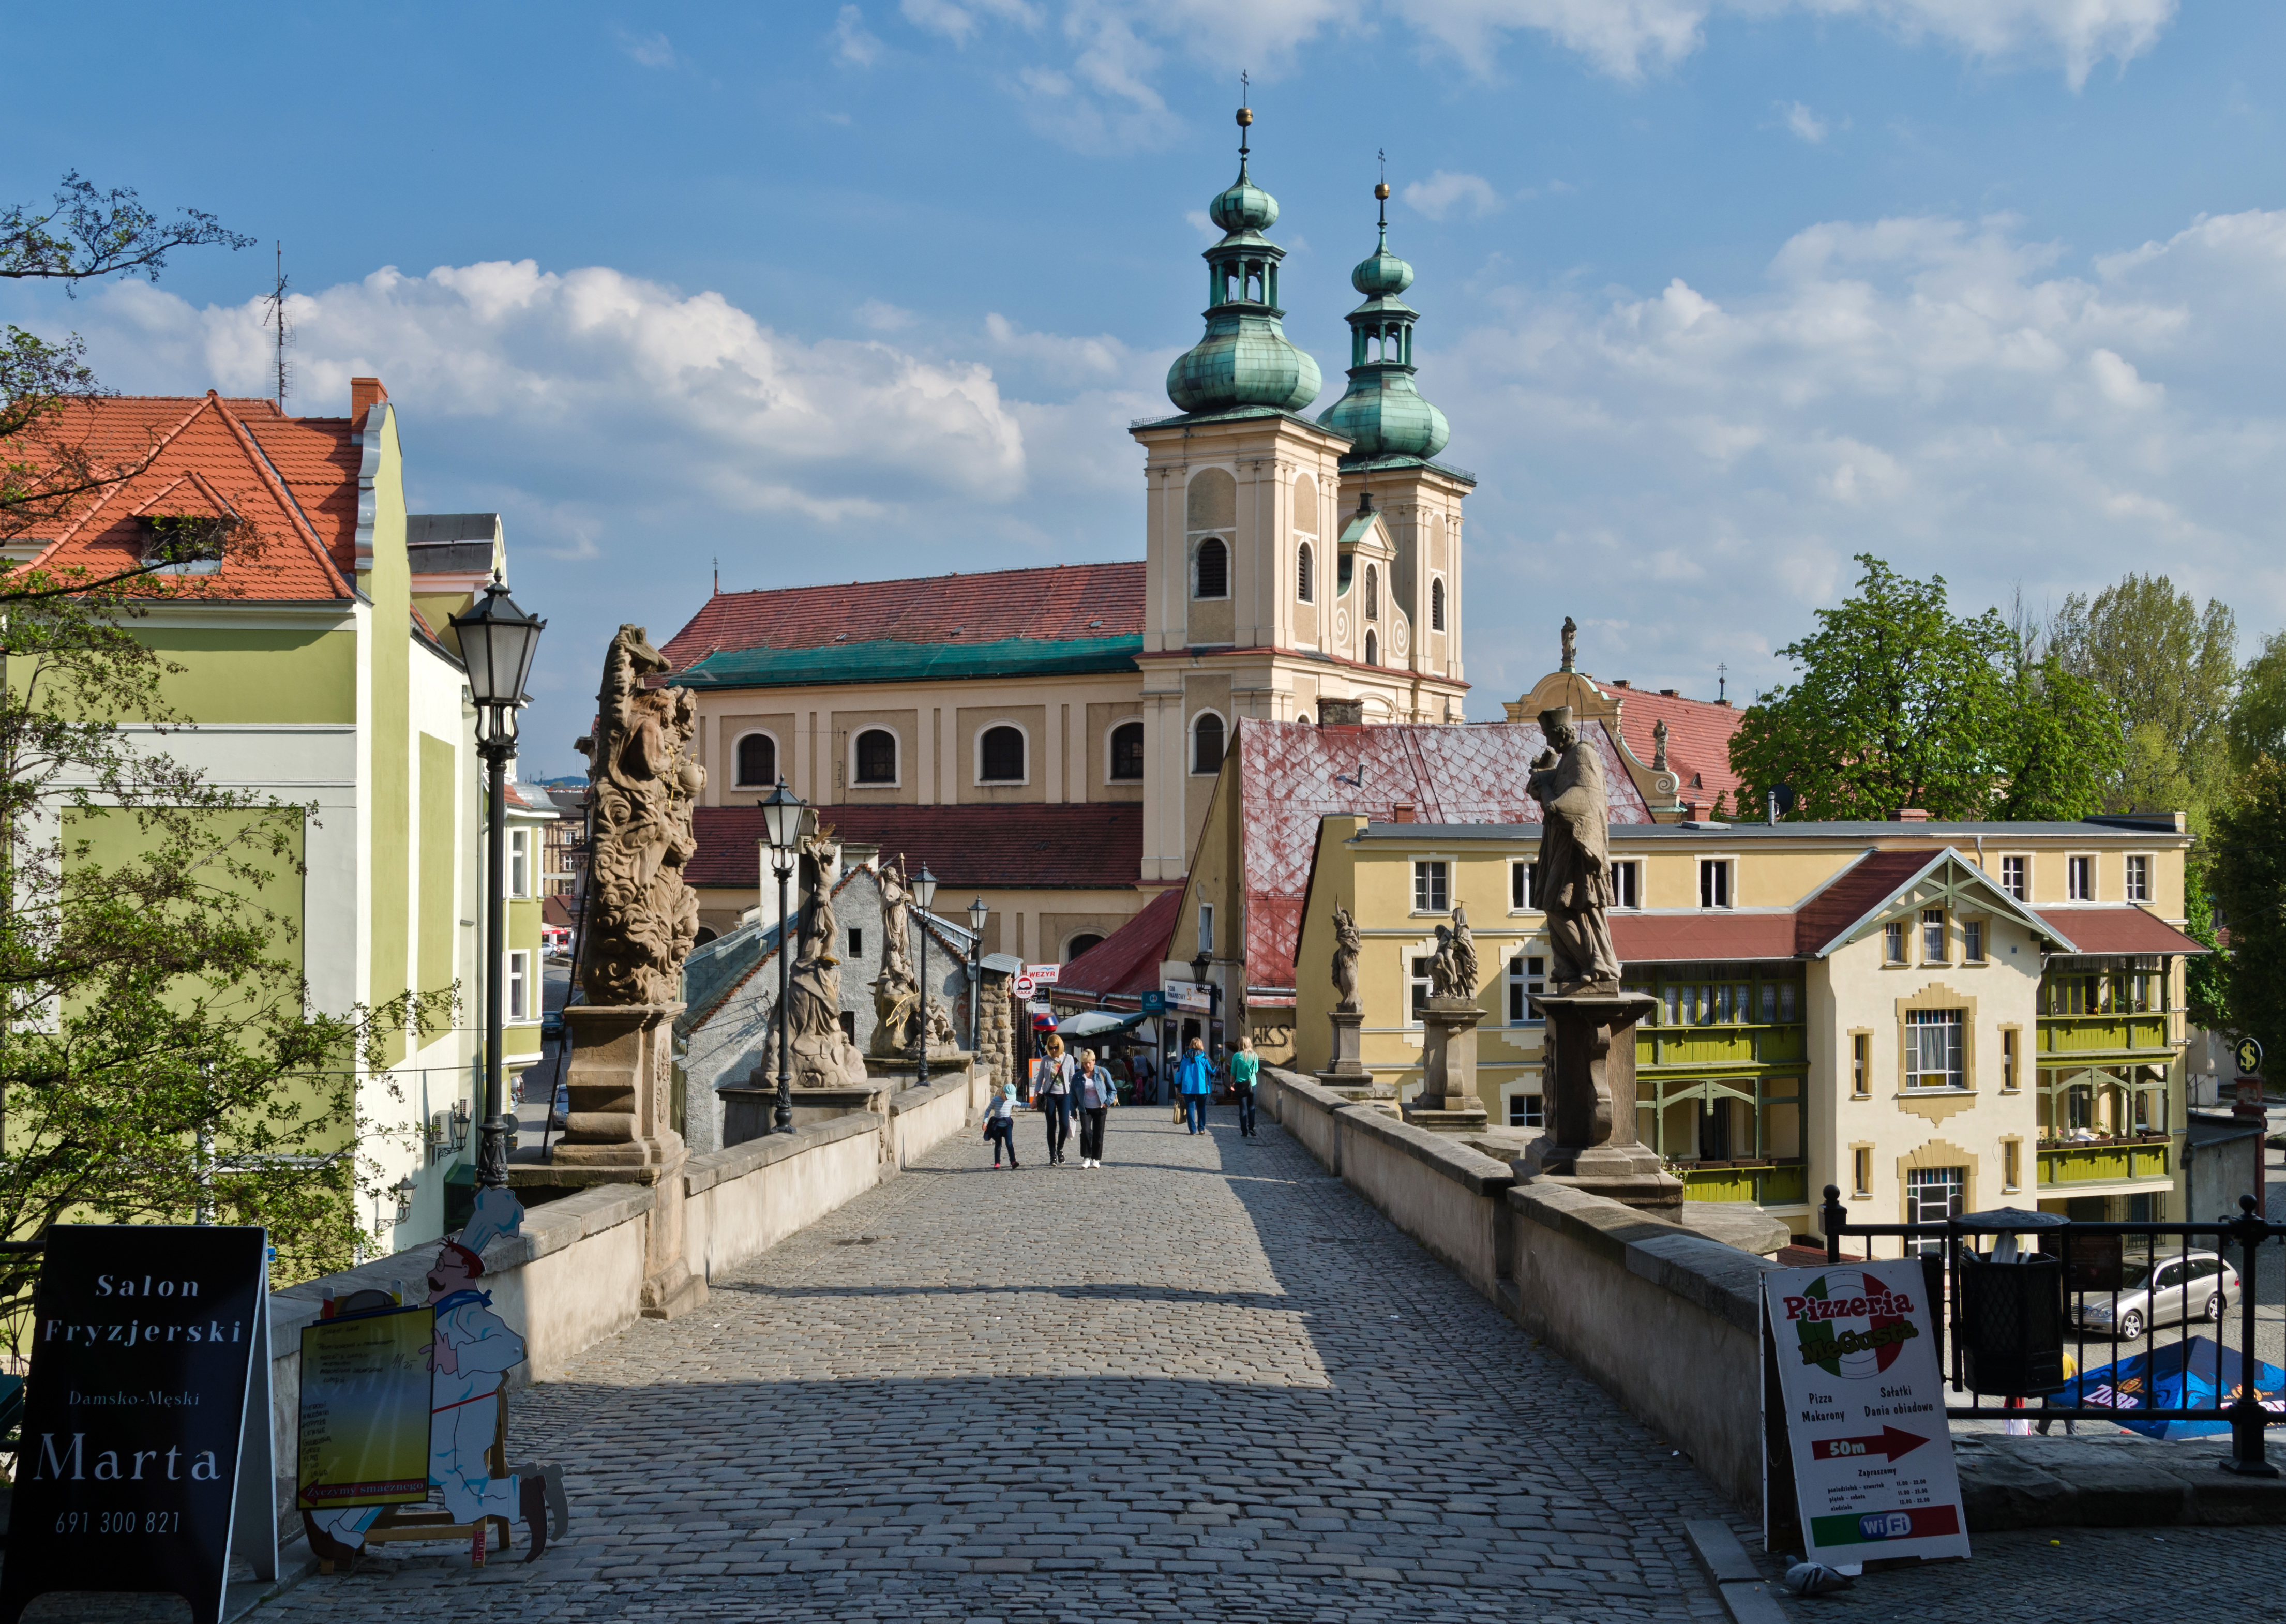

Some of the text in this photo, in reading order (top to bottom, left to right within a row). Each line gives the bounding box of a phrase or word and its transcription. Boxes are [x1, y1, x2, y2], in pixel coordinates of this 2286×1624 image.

[1252, 1024, 1291, 1047] WKS
[95, 1274, 199, 1297] Salon
[1782, 1290, 1915, 1321] Pizzeria
[43, 1319, 240, 1347] Fryzjerski
[1798, 1320, 1919, 1365] MeGusta
[69, 1390, 199, 1408] Damsko-Męski
[1809, 1393, 1832, 1404] Pizza
[1880, 1385, 1912, 1398] Sałatki
[1802, 1410, 1844, 1422] Makarony
[1864, 1401, 1933, 1417] Dania obiadowe
[32, 1433, 221, 1480] Marta
[1829, 1440, 1866, 1456] 50m
[1858, 1468, 1897, 1478] Zapraszamy
[307, 1482, 424, 1498] Życzymy smacznego
[1828, 1485, 1857, 1494] poniedziałek
[55, 1512, 179, 1533] 691 300 821
